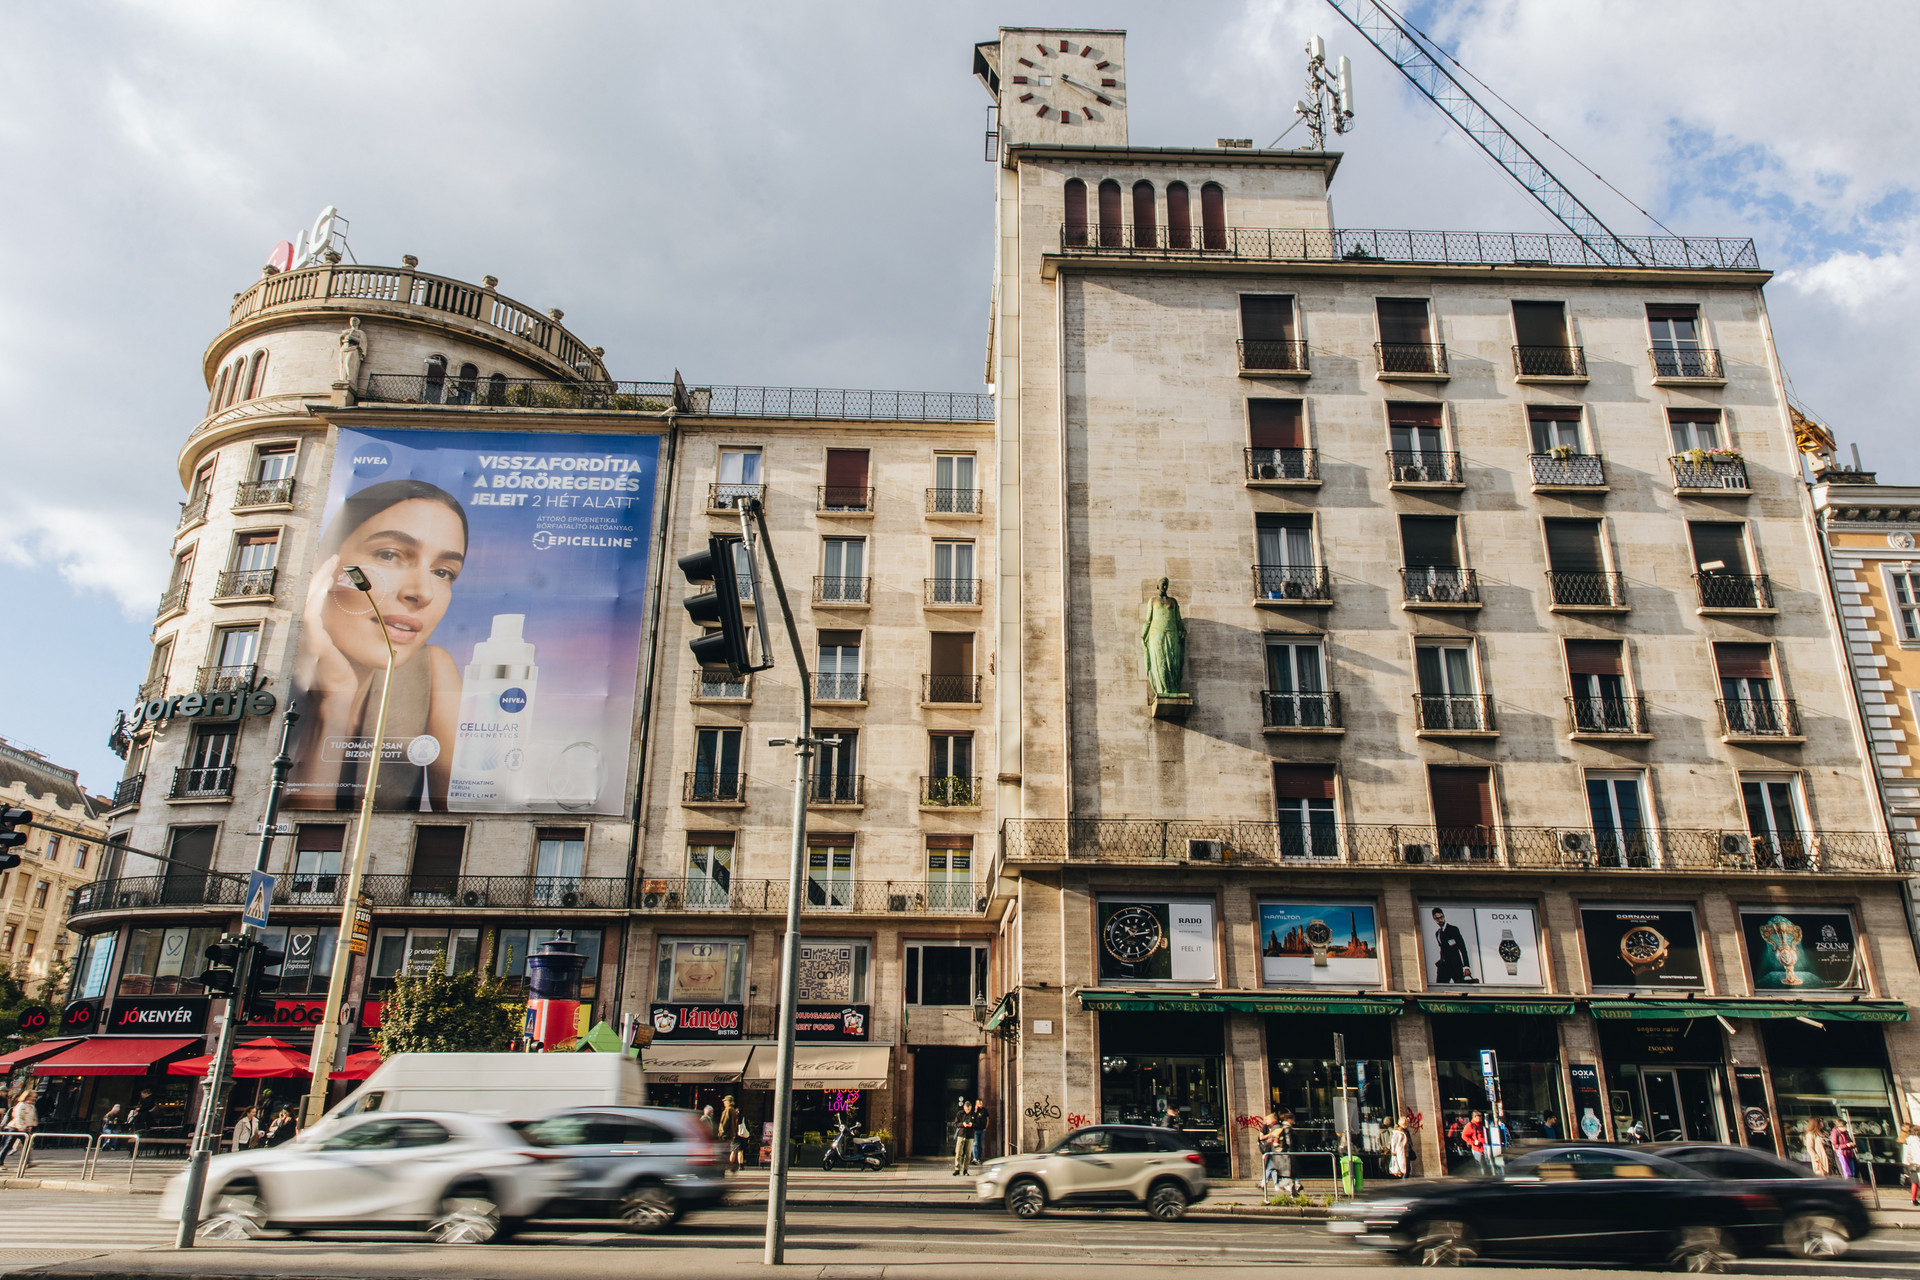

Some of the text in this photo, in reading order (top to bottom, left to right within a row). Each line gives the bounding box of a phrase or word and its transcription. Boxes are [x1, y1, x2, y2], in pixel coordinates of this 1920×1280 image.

[291, 205, 337, 271] LG
[353, 456, 388, 465] NIVEA
[478, 455, 642, 473] VISSZAFORDÍTJA
[473, 472, 640, 492] A BŐRÖREGEDÉS
[469, 493, 529, 506] JELEIT
[531, 496, 541, 507] 2
[546, 493, 580, 508] HÉT
[568, 516, 618, 524] EPIGENETIKAI
[589, 523, 634, 532] HATÓANYAG
[460, 722, 519, 732] CELLULAR
[330, 740, 403, 750] TUDOMÁNOSAN
[345, 749, 403, 759] BIZONTOTT
[1815, 942, 1849, 950] ZSOLNAY
[1088, 1002, 1121, 1010] DOXA
[1255, 1004, 1326, 1012] CORNAVIN
[68, 1008, 90, 1024] JÓ
[118, 1006, 192, 1025] JÓKENYÉR
[679, 1006, 738, 1031] Lángos
[1600, 1009, 1632, 1018] RADO
[21, 1012, 45, 1028] JÓ
[812, 1023, 836, 1031] FOOD
